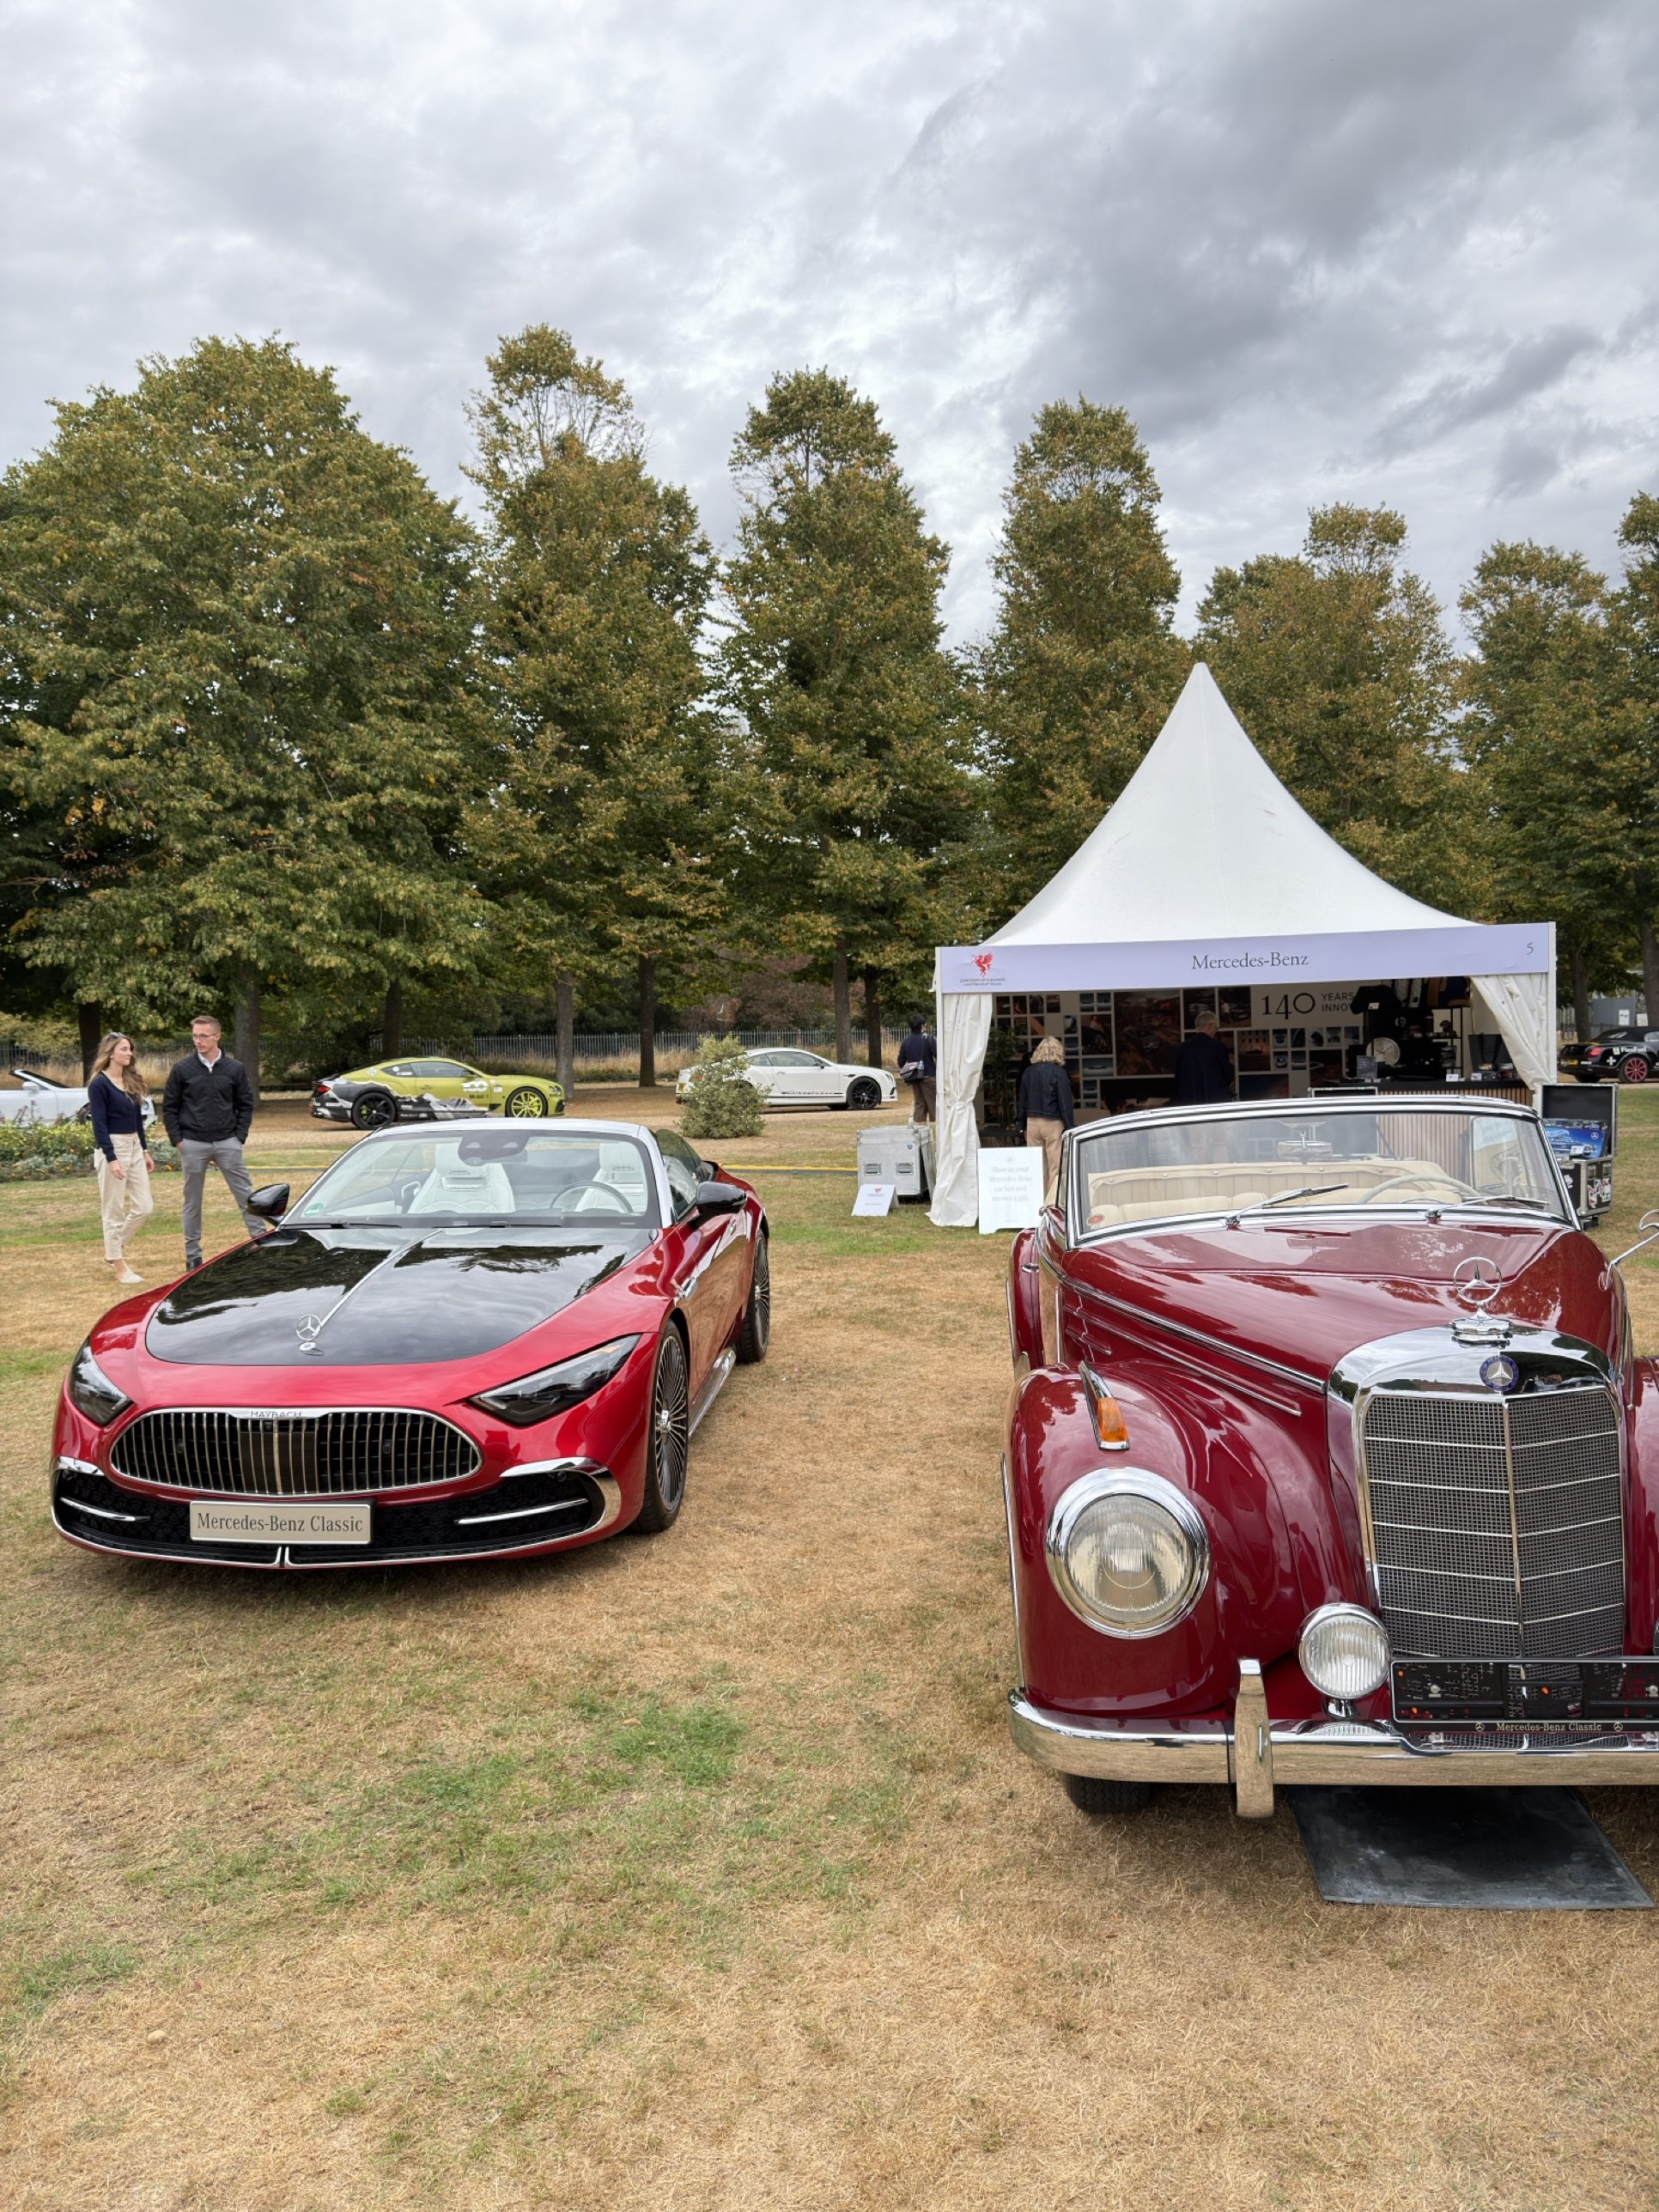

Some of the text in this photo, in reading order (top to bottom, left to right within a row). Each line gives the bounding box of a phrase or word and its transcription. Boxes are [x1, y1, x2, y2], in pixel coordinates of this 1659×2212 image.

[1526, 942, 1534, 955] 5
[1192, 951, 1309, 969] Mercedes-Benz
[1322, 992, 1354, 1001] YEARS
[1261, 993, 1316, 1020] 140
[197, 1512, 363, 1533] Mercedes-Benz Classic
[1496, 1723, 1601, 1731] Mercedes-Benz Classic
